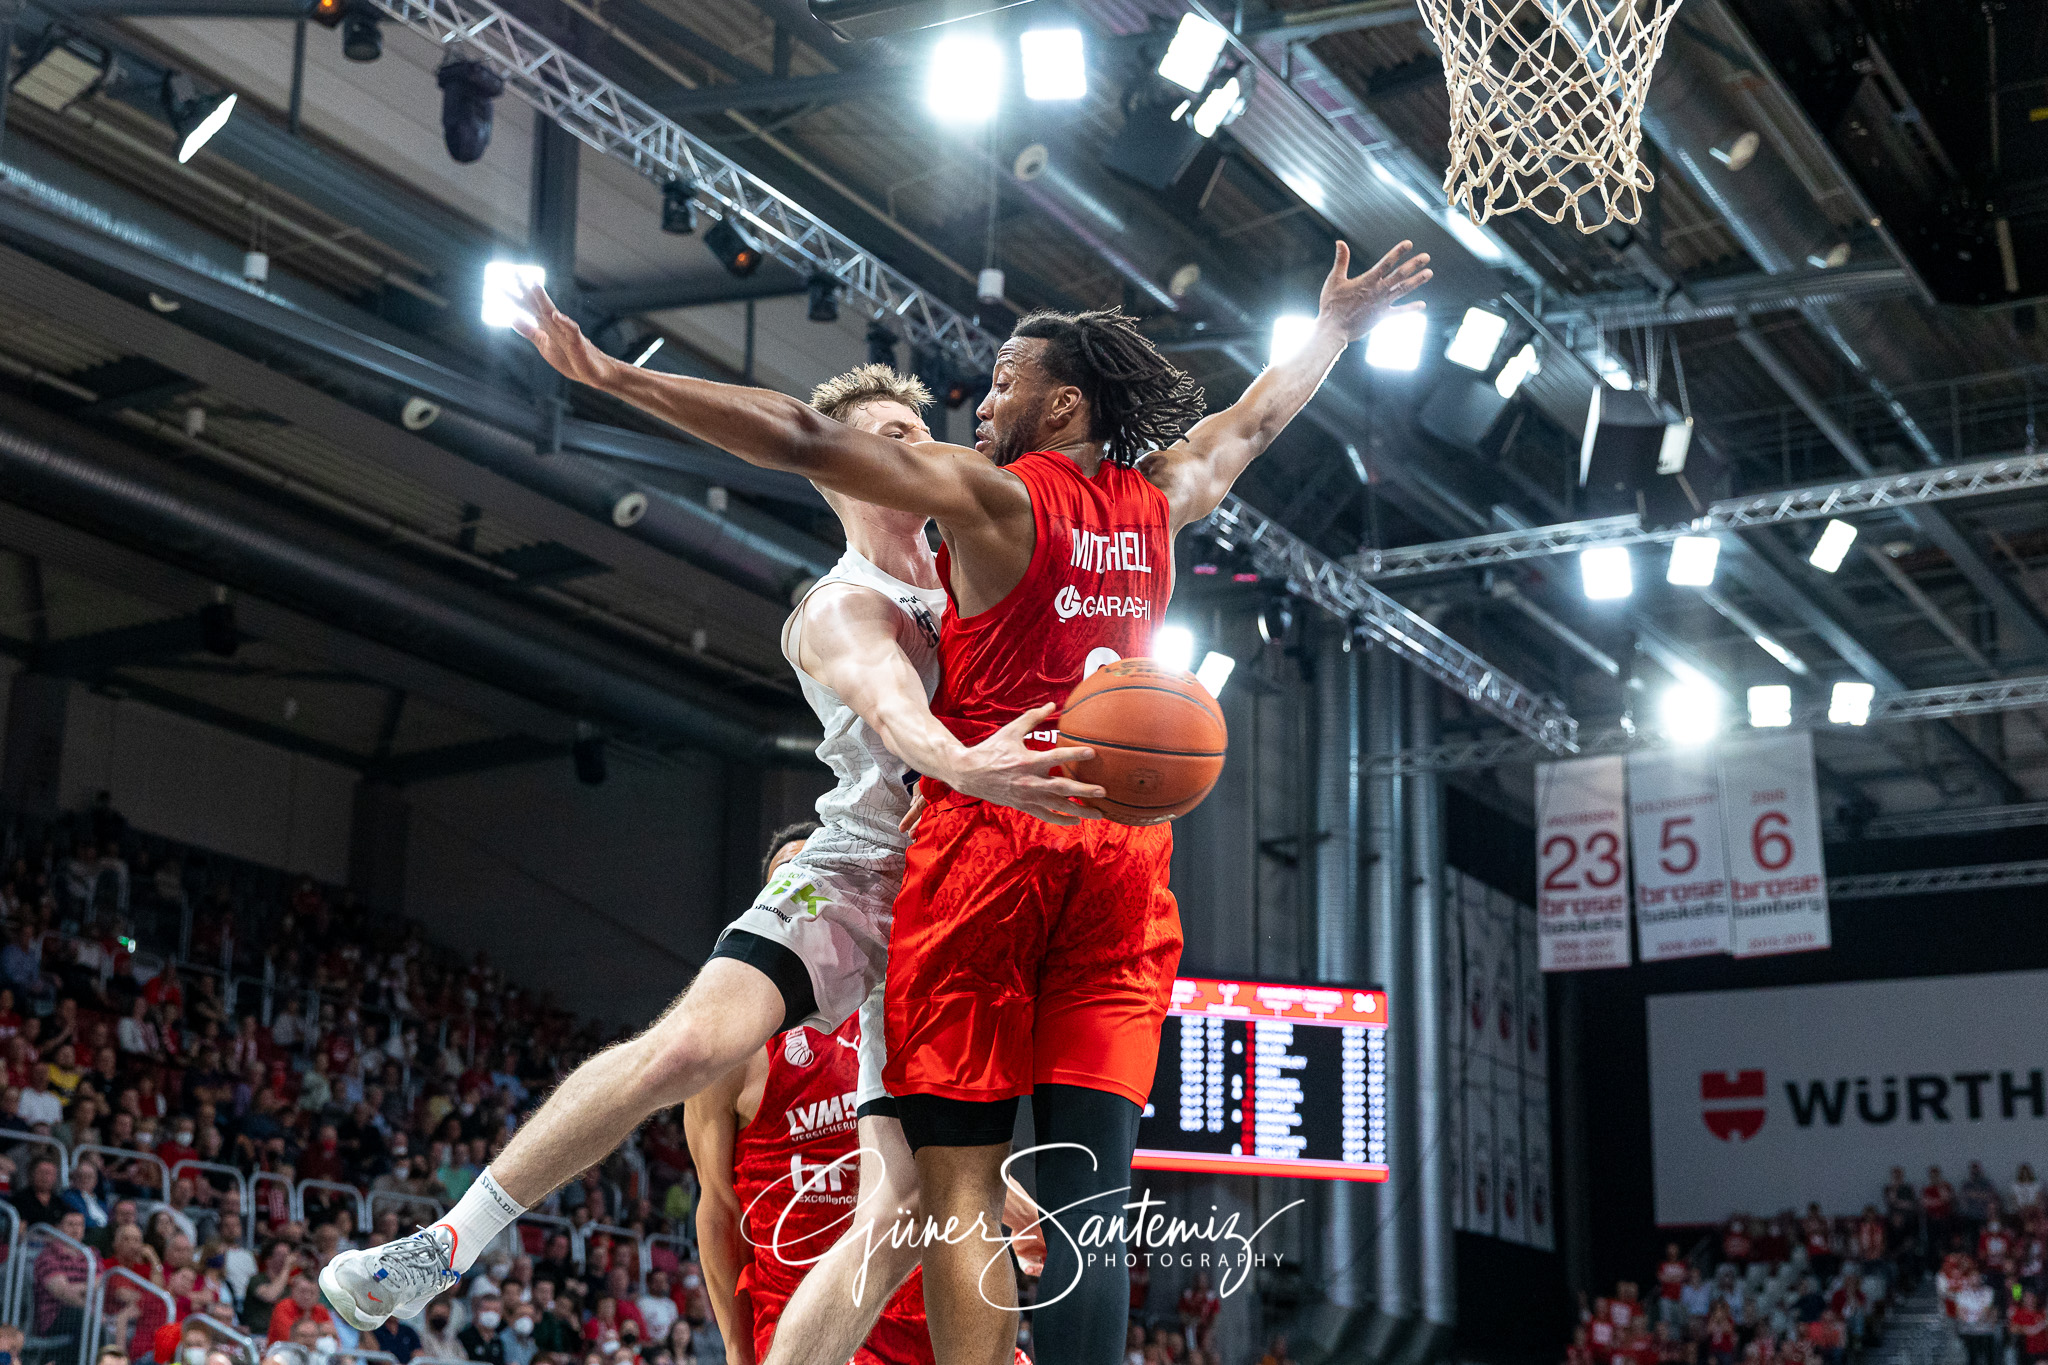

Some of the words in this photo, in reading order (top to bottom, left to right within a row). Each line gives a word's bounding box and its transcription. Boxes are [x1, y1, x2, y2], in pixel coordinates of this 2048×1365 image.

[1542, 829, 1621, 891] 23
[1659, 815, 1699, 875] 5
[1751, 810, 1794, 872] 6
[1785, 1069, 2046, 1128] WÜRTH
